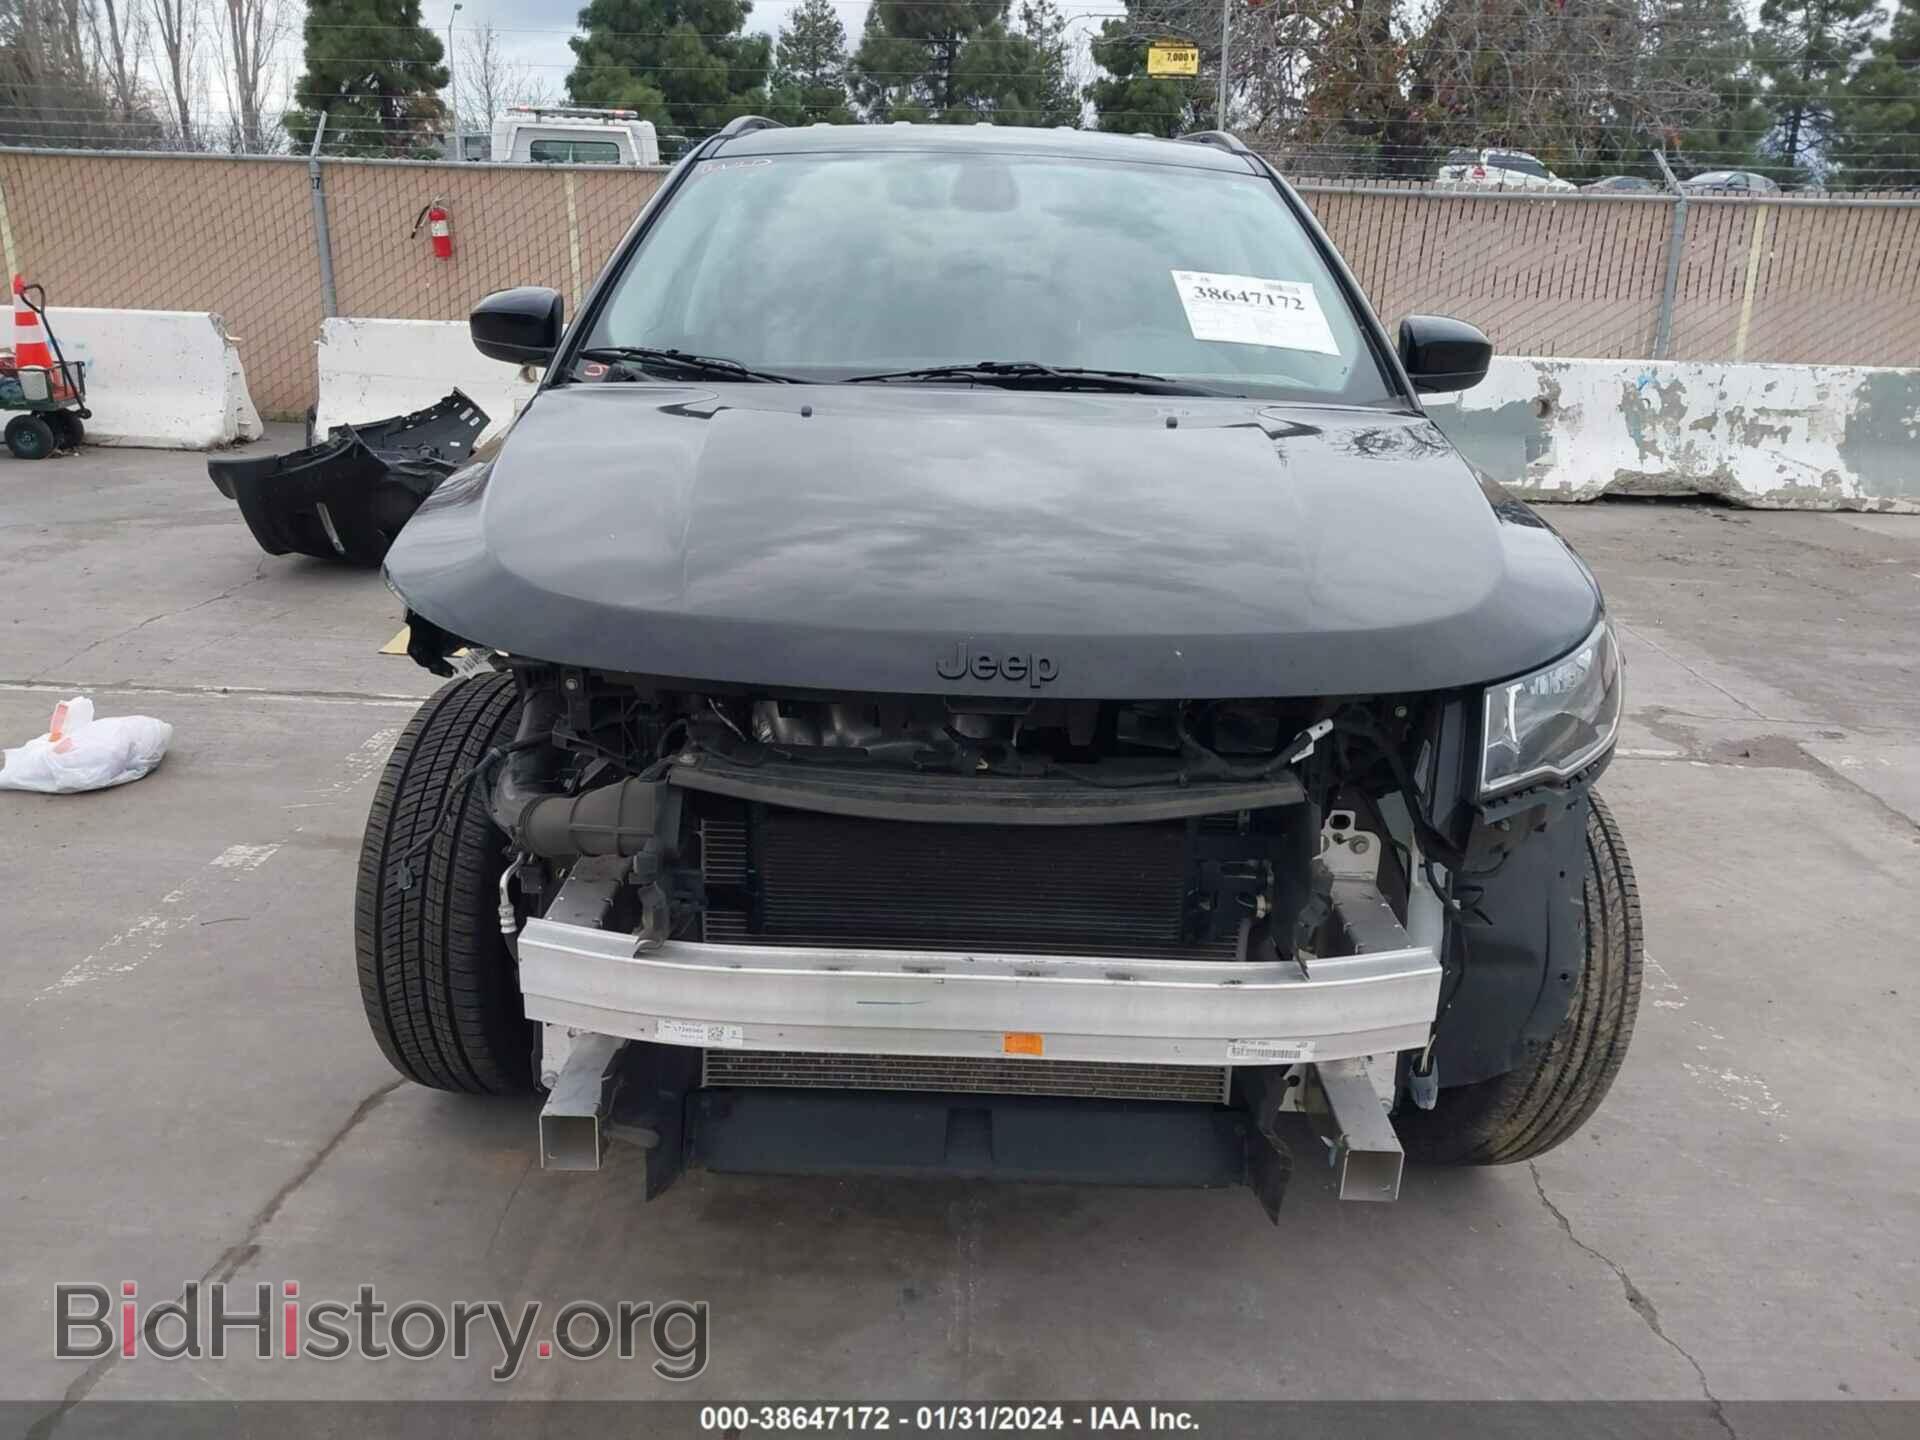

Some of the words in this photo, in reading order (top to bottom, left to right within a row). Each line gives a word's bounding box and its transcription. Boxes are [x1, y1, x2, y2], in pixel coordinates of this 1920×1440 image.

[1167, 52, 1189, 62] 7,000
[1193, 286, 1305, 312] 38647172
[936, 640, 1059, 688] Jeep
